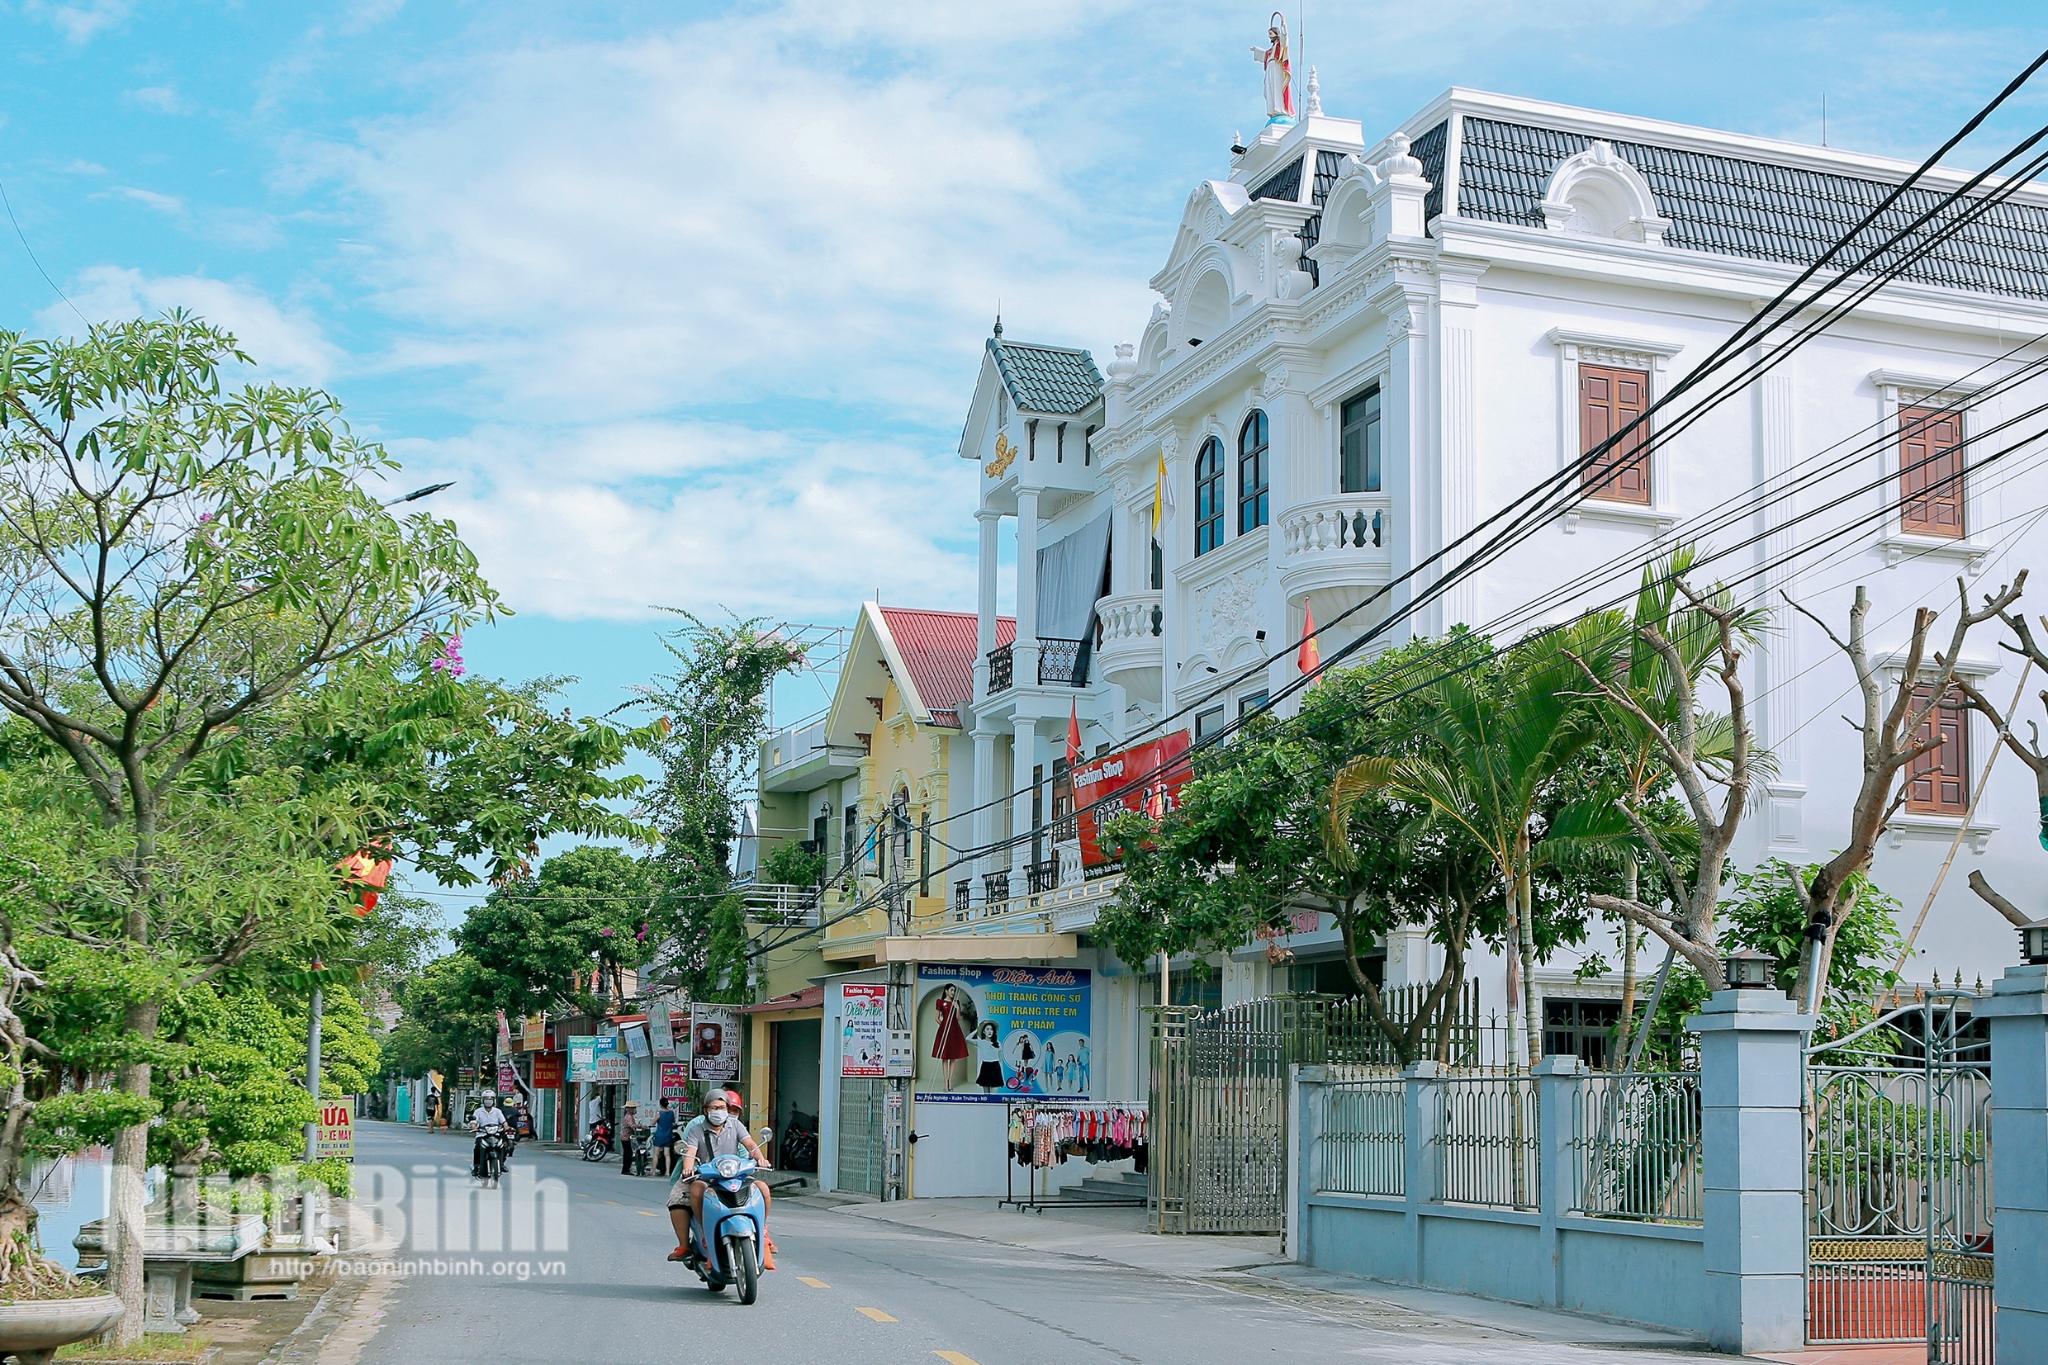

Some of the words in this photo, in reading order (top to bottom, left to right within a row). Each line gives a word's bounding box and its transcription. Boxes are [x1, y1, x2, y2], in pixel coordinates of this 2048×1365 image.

[1073, 766, 1103, 789] Fashion
[1103, 759, 1125, 780] Shop
[922, 966, 957, 976] Fashion
[959, 967, 982, 979] Shop
[992, 968, 1035, 988] Diệu
[1036, 968, 1076, 986] Anh
[863, 988, 875, 996] Shop
[1008, 992, 1038, 1002] TRANG
[1012, 1006, 1041, 1016] TRANG
[1063, 1007, 1077, 1016] EM
[328, 1130, 337, 1140] XE
